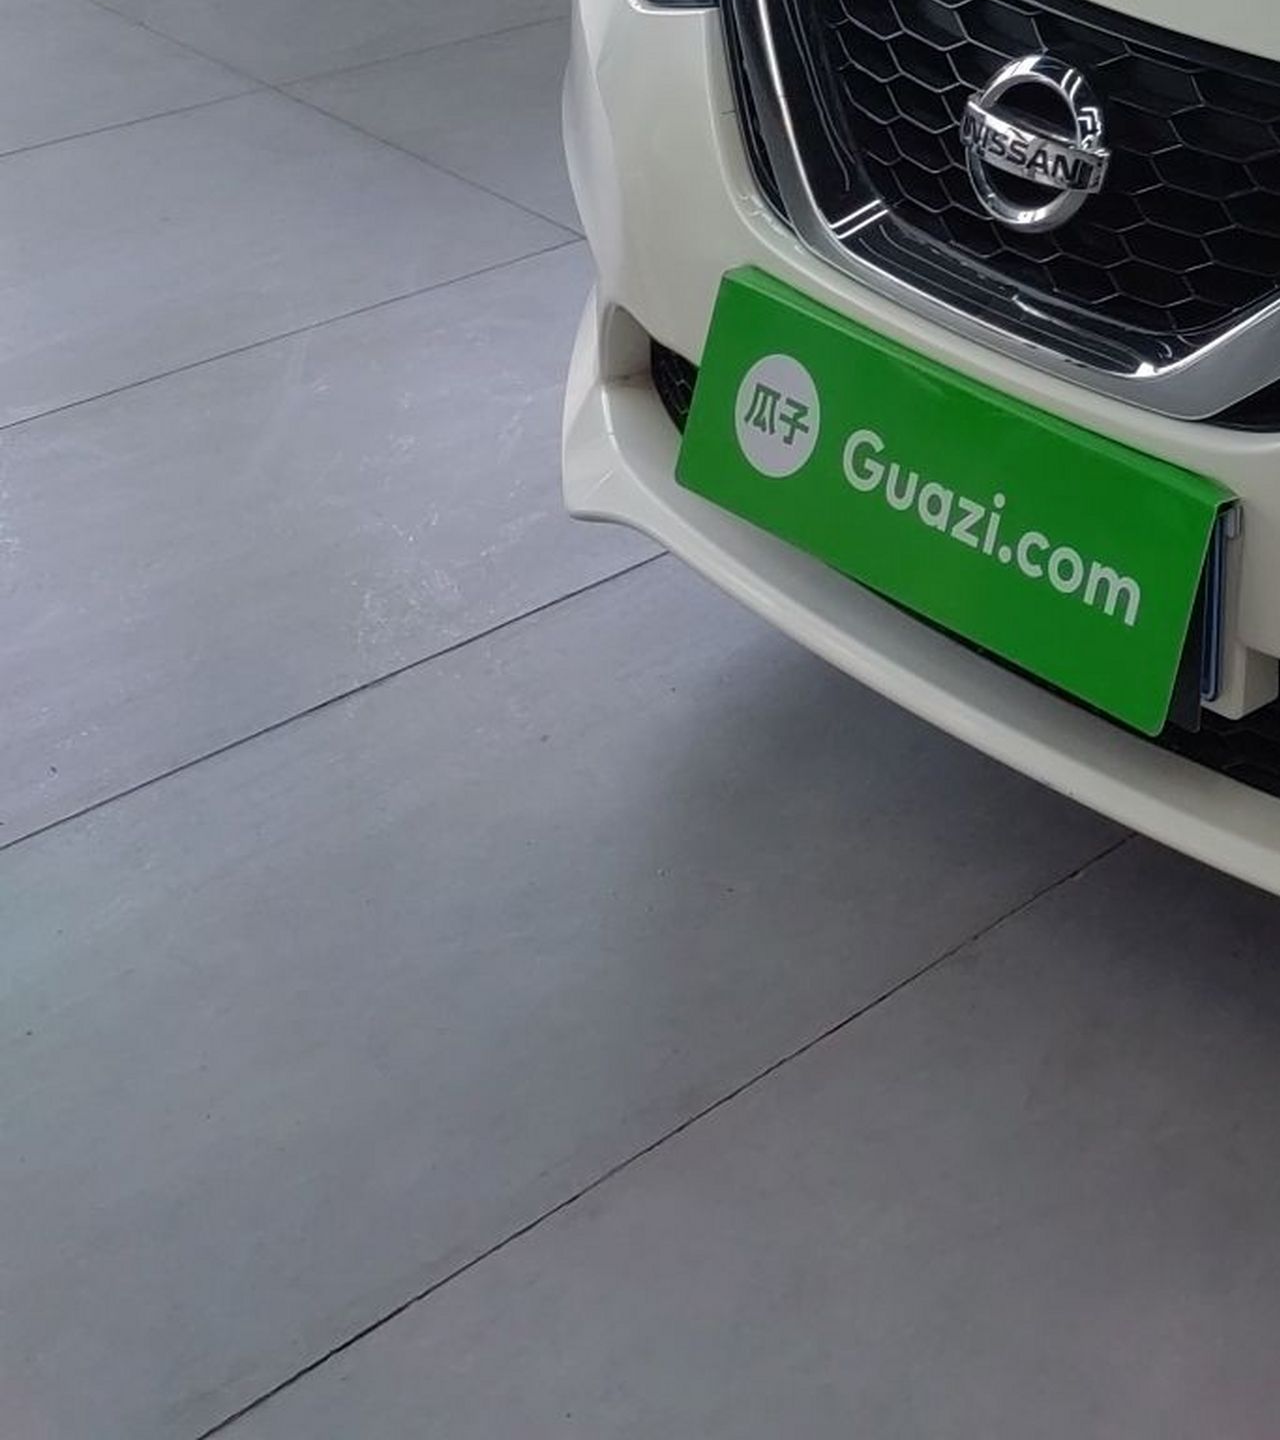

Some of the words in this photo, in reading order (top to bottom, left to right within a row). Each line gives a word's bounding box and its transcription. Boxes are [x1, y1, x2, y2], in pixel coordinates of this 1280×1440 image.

[962, 112, 1093, 190] NISSAN
[743, 382, 811, 445] 瓜子
[842, 428, 1142, 627] Guazi.com
